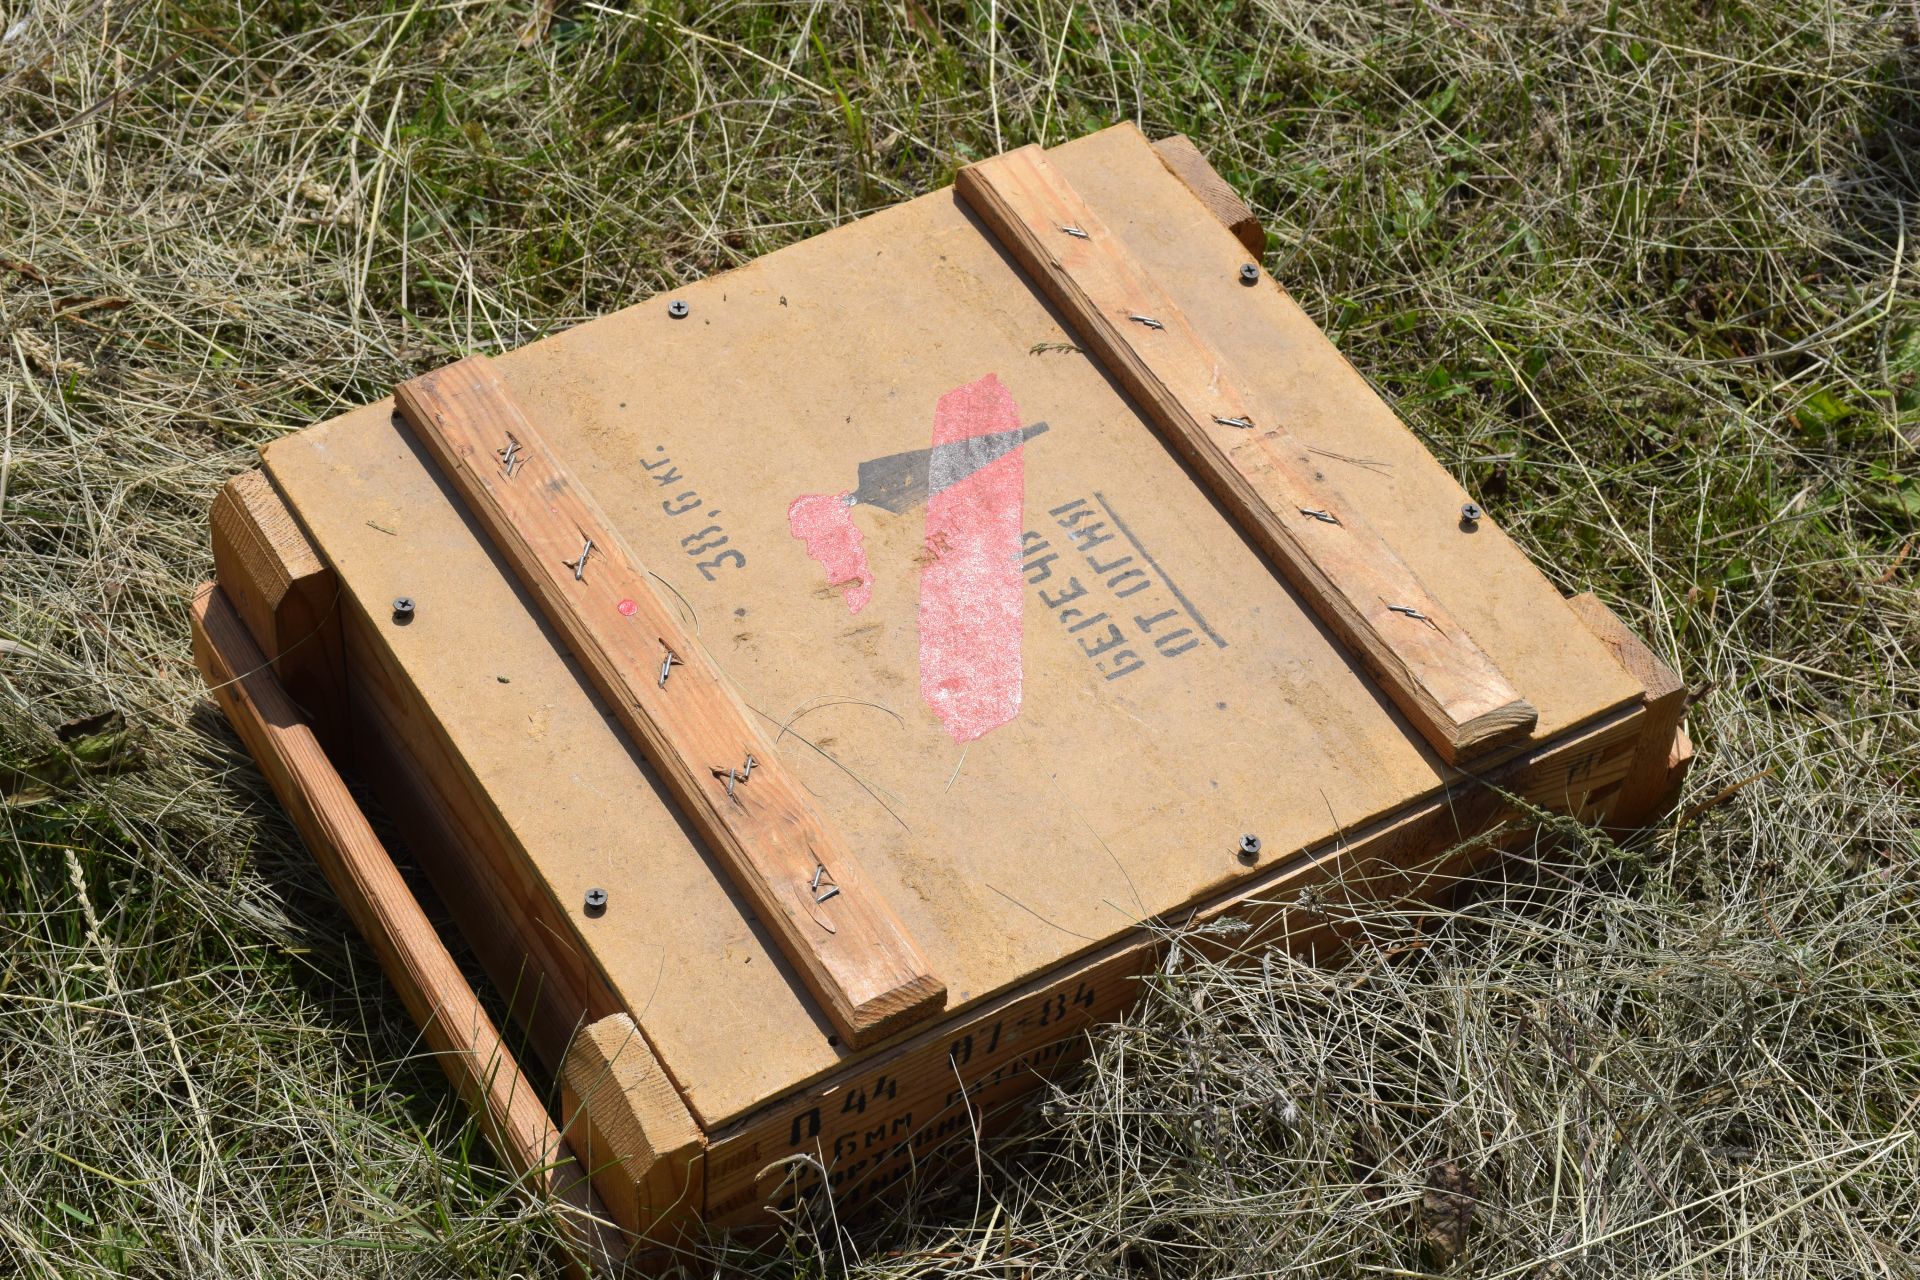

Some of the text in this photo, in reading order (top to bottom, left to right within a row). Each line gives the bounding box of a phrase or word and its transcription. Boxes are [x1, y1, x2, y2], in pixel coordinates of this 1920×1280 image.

[660, 490, 748, 582] 38,6
[1012, 530, 1146, 682] БЕРЕЧЬ
[1048, 498, 1200, 658] ОТ ОГНЯ
